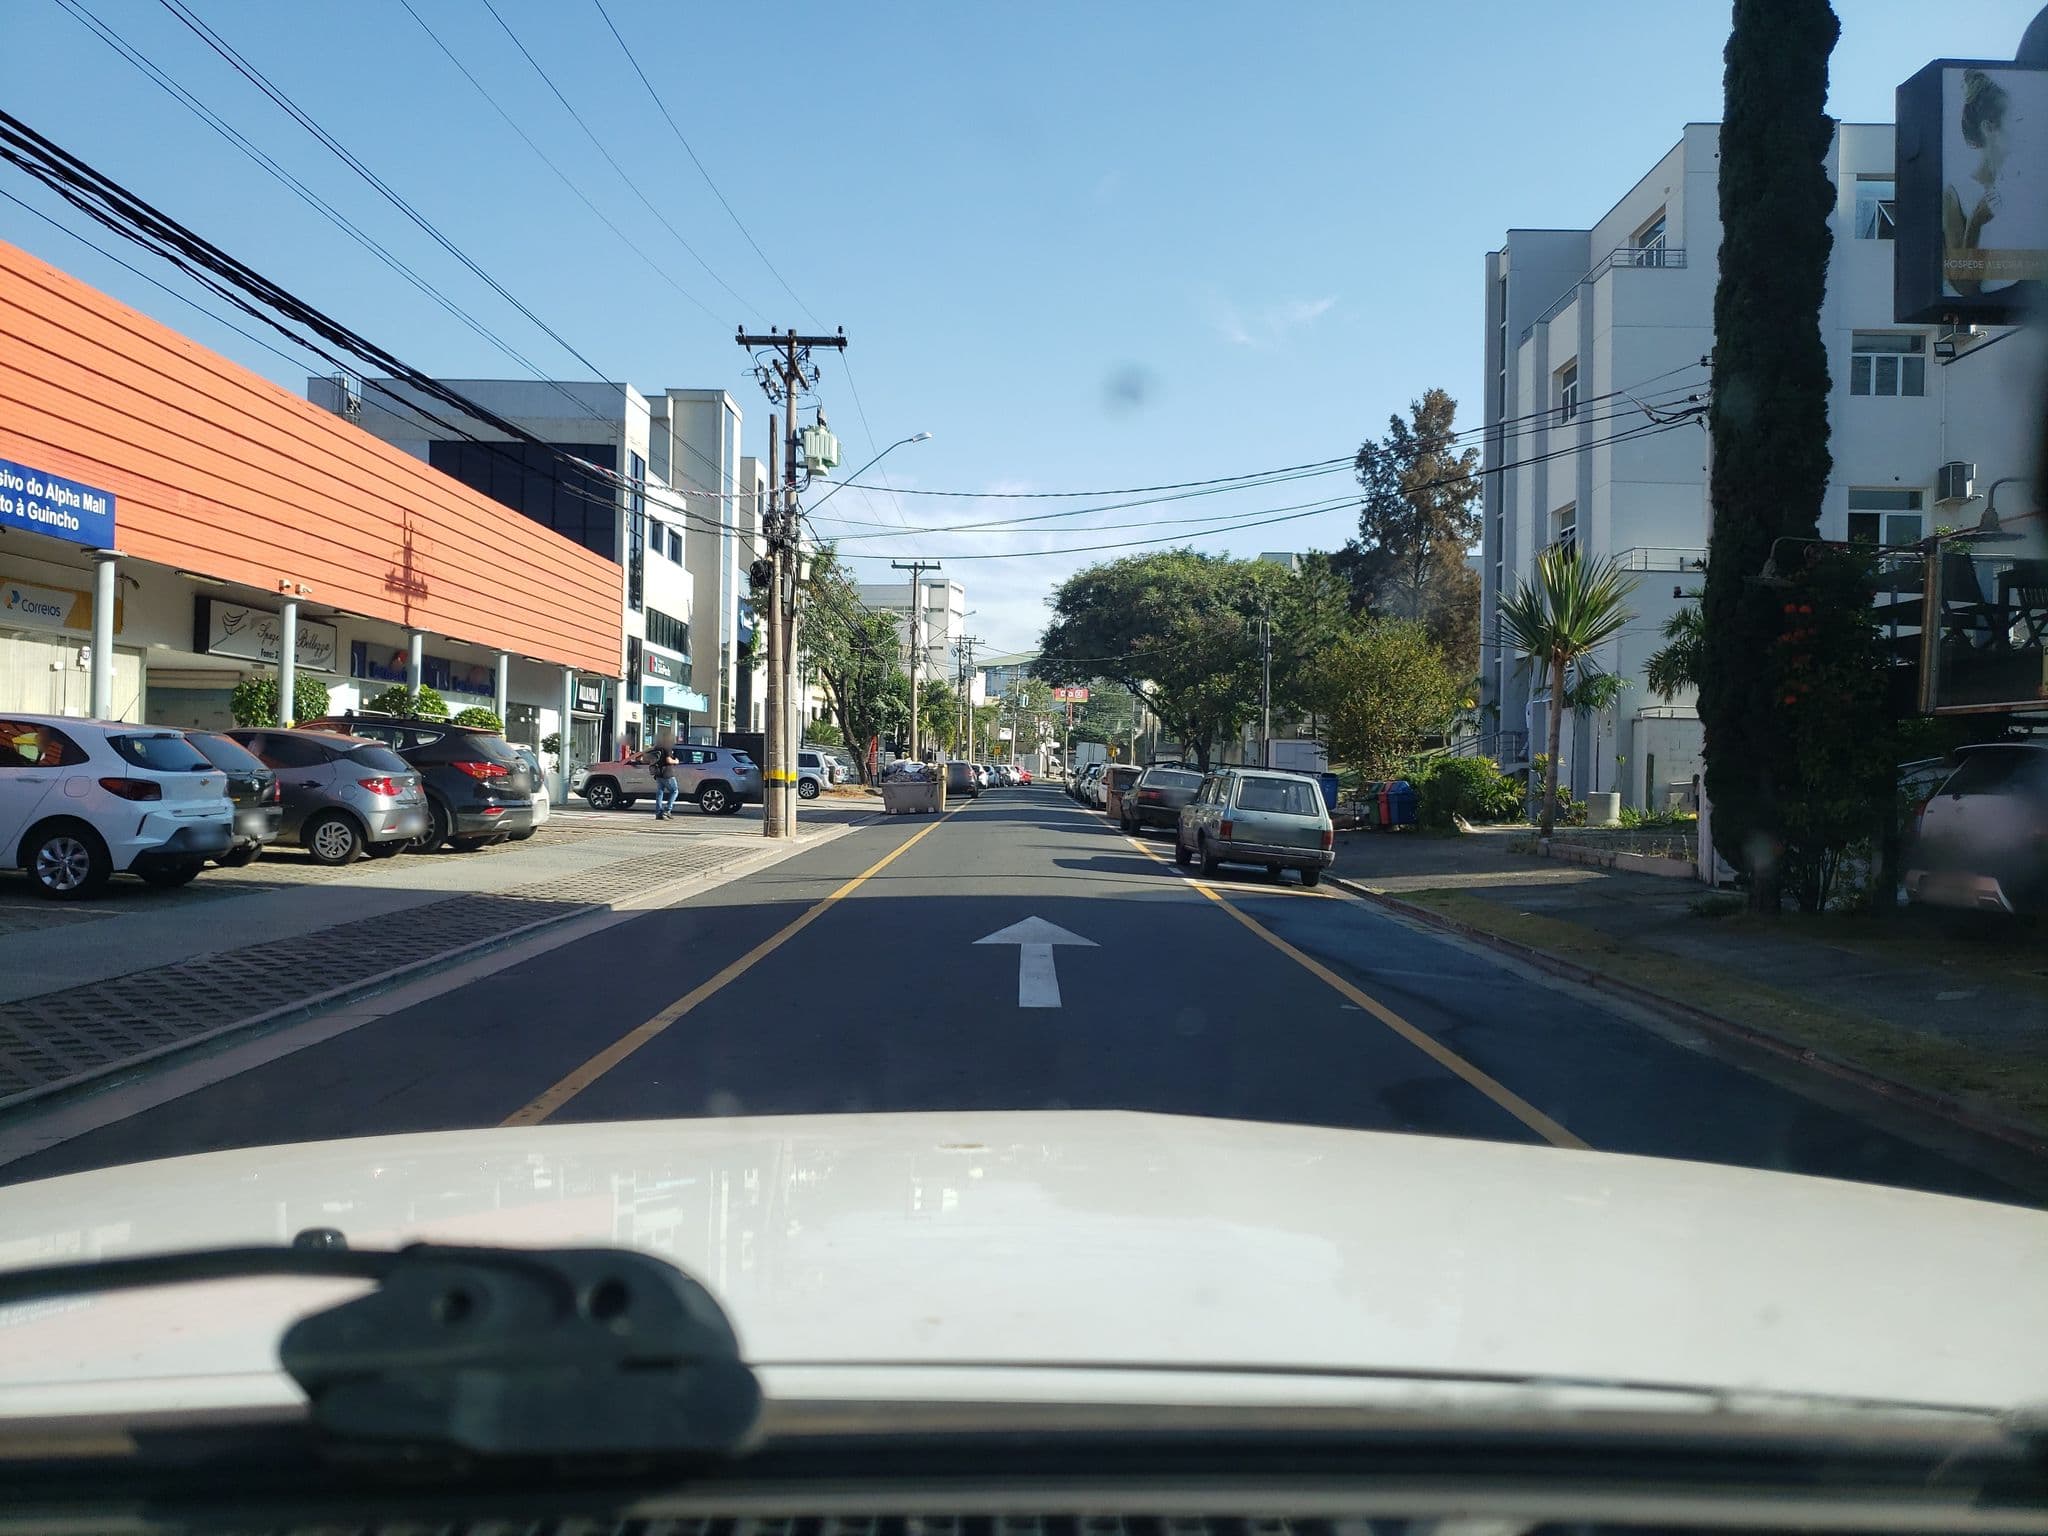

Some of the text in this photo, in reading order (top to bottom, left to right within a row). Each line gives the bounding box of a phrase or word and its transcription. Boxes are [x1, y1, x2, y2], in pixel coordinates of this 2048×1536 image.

[26, 477, 44, 497] do
[45, 482, 80, 508] Alpha
[82, 492, 106, 515] Mall
[16, 498, 25, 517] à
[27, 501, 80, 531] Guincho
[21, 599, 61, 617] Correios
